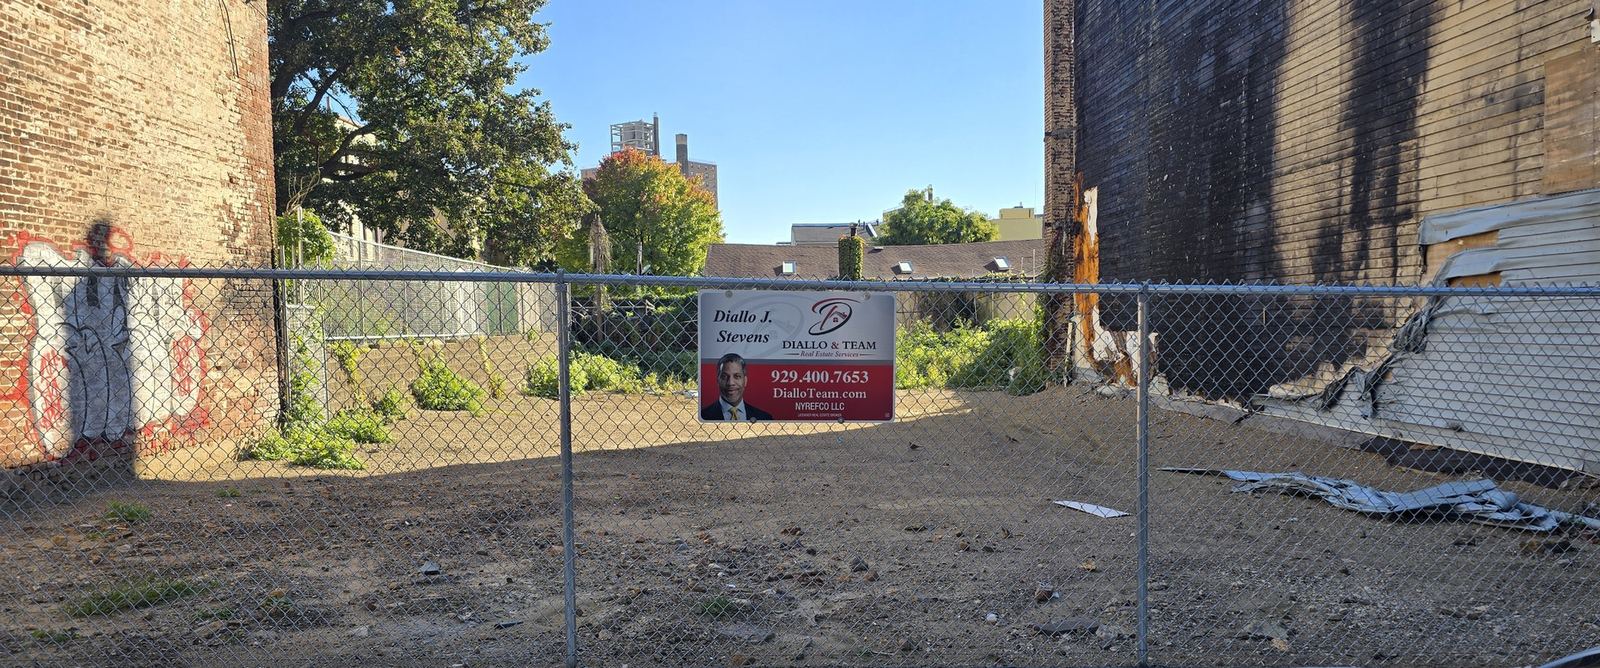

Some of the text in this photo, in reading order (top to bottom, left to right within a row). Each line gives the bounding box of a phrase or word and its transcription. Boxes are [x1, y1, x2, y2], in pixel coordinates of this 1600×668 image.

[713, 310, 772, 323] Diallo J.
[717, 330, 769, 343] Stevens
[783, 341, 876, 350] DIALLO & TEAM
[771, 370, 869, 383] 929.400.7653
[773, 388, 866, 399] DialloTeam.com
[795, 402, 845, 411] NYREFCO LLC
